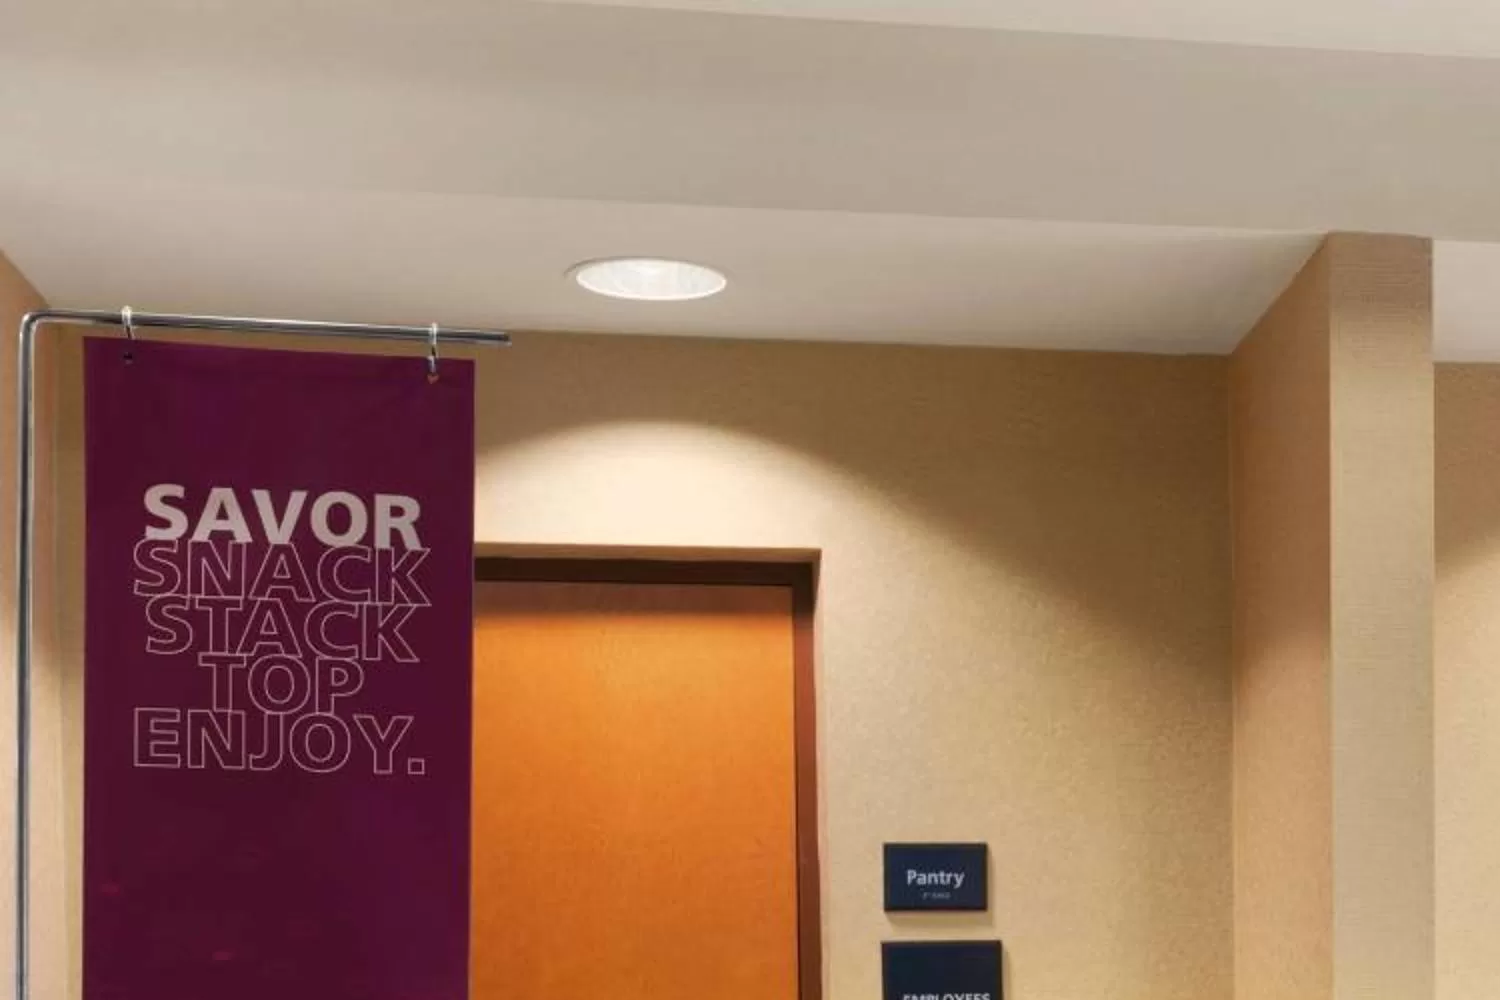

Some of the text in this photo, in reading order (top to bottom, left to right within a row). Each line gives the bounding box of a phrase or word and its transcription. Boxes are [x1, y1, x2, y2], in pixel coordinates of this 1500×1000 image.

[143, 484, 423, 551] SAVOR
[133, 538, 432, 607] SNACK
[145, 594, 421, 662] STACK
[197, 652, 365, 716] TOP
[133, 707, 426, 775] ENJOY.
[906, 868, 966, 889] Pantry
